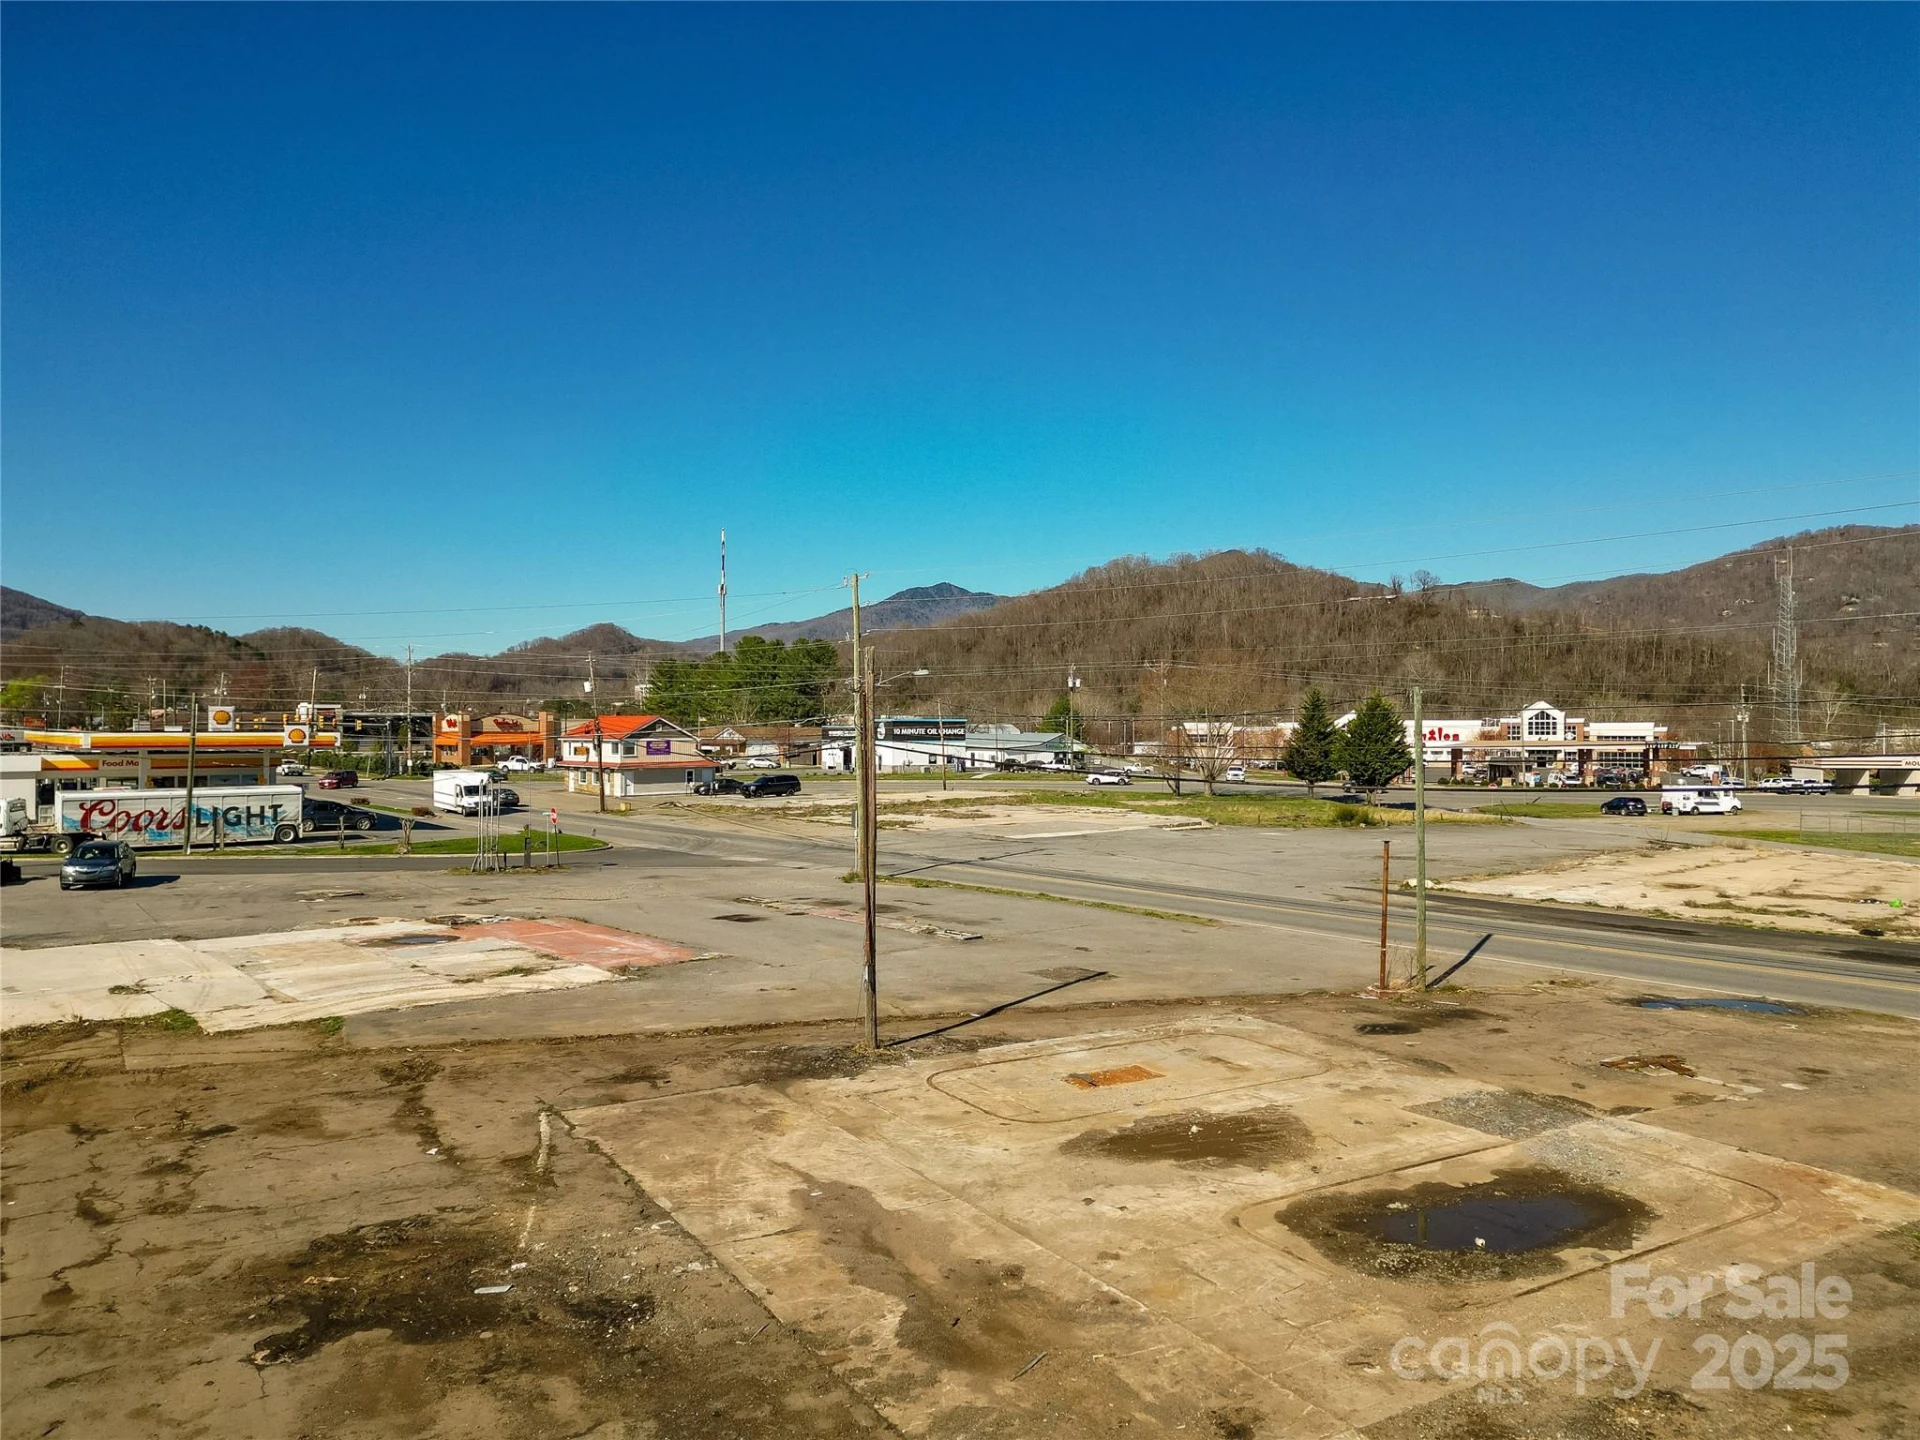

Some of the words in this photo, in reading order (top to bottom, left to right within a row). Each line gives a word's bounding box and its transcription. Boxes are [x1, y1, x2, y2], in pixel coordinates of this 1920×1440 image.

[102, 759, 124, 767] Food
[79, 799, 187, 832] Coors
[196, 803, 284, 829] LIGHT
